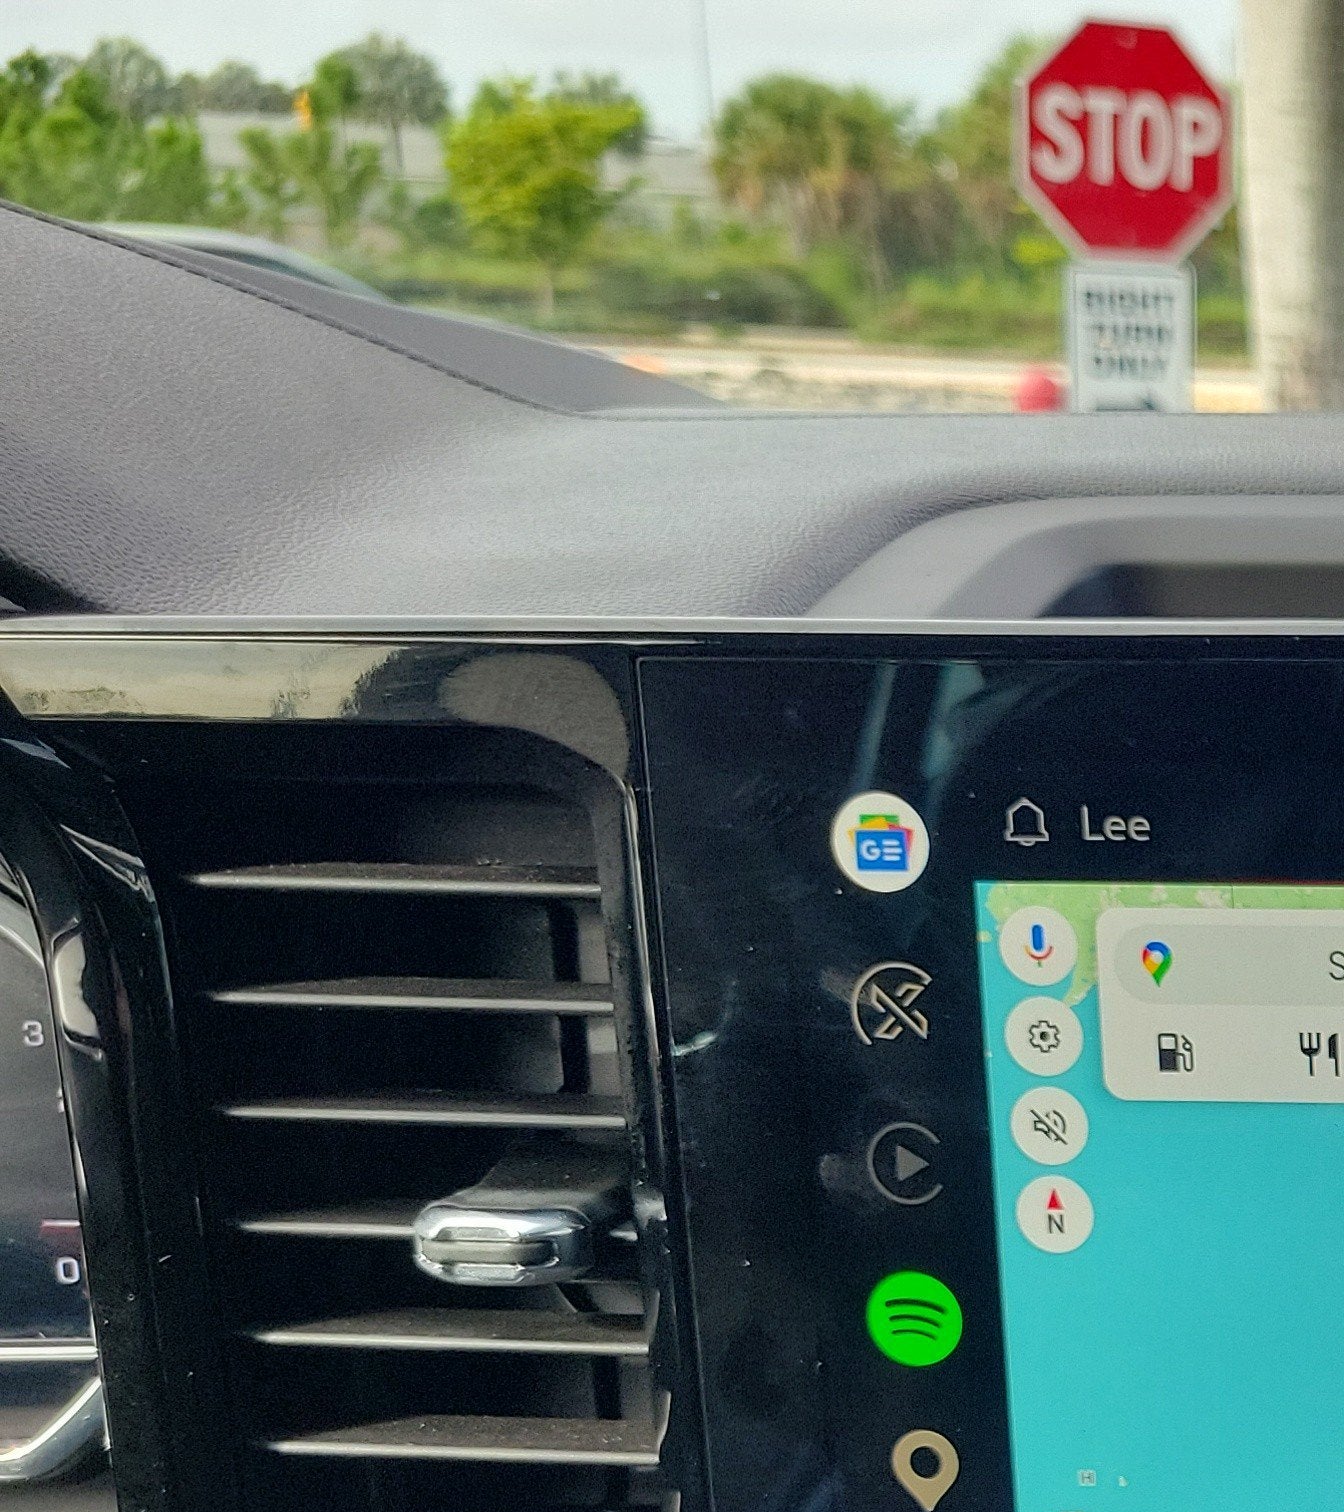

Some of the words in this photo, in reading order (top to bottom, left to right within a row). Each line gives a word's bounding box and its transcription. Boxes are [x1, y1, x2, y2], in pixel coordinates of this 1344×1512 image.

[1032, 83, 1222, 192] STOP
[1079, 804, 1152, 842] Lee
[22, 1020, 45, 1047] 3
[1047, 1213, 1065, 1235] N
[57, 1257, 80, 1284] 0
